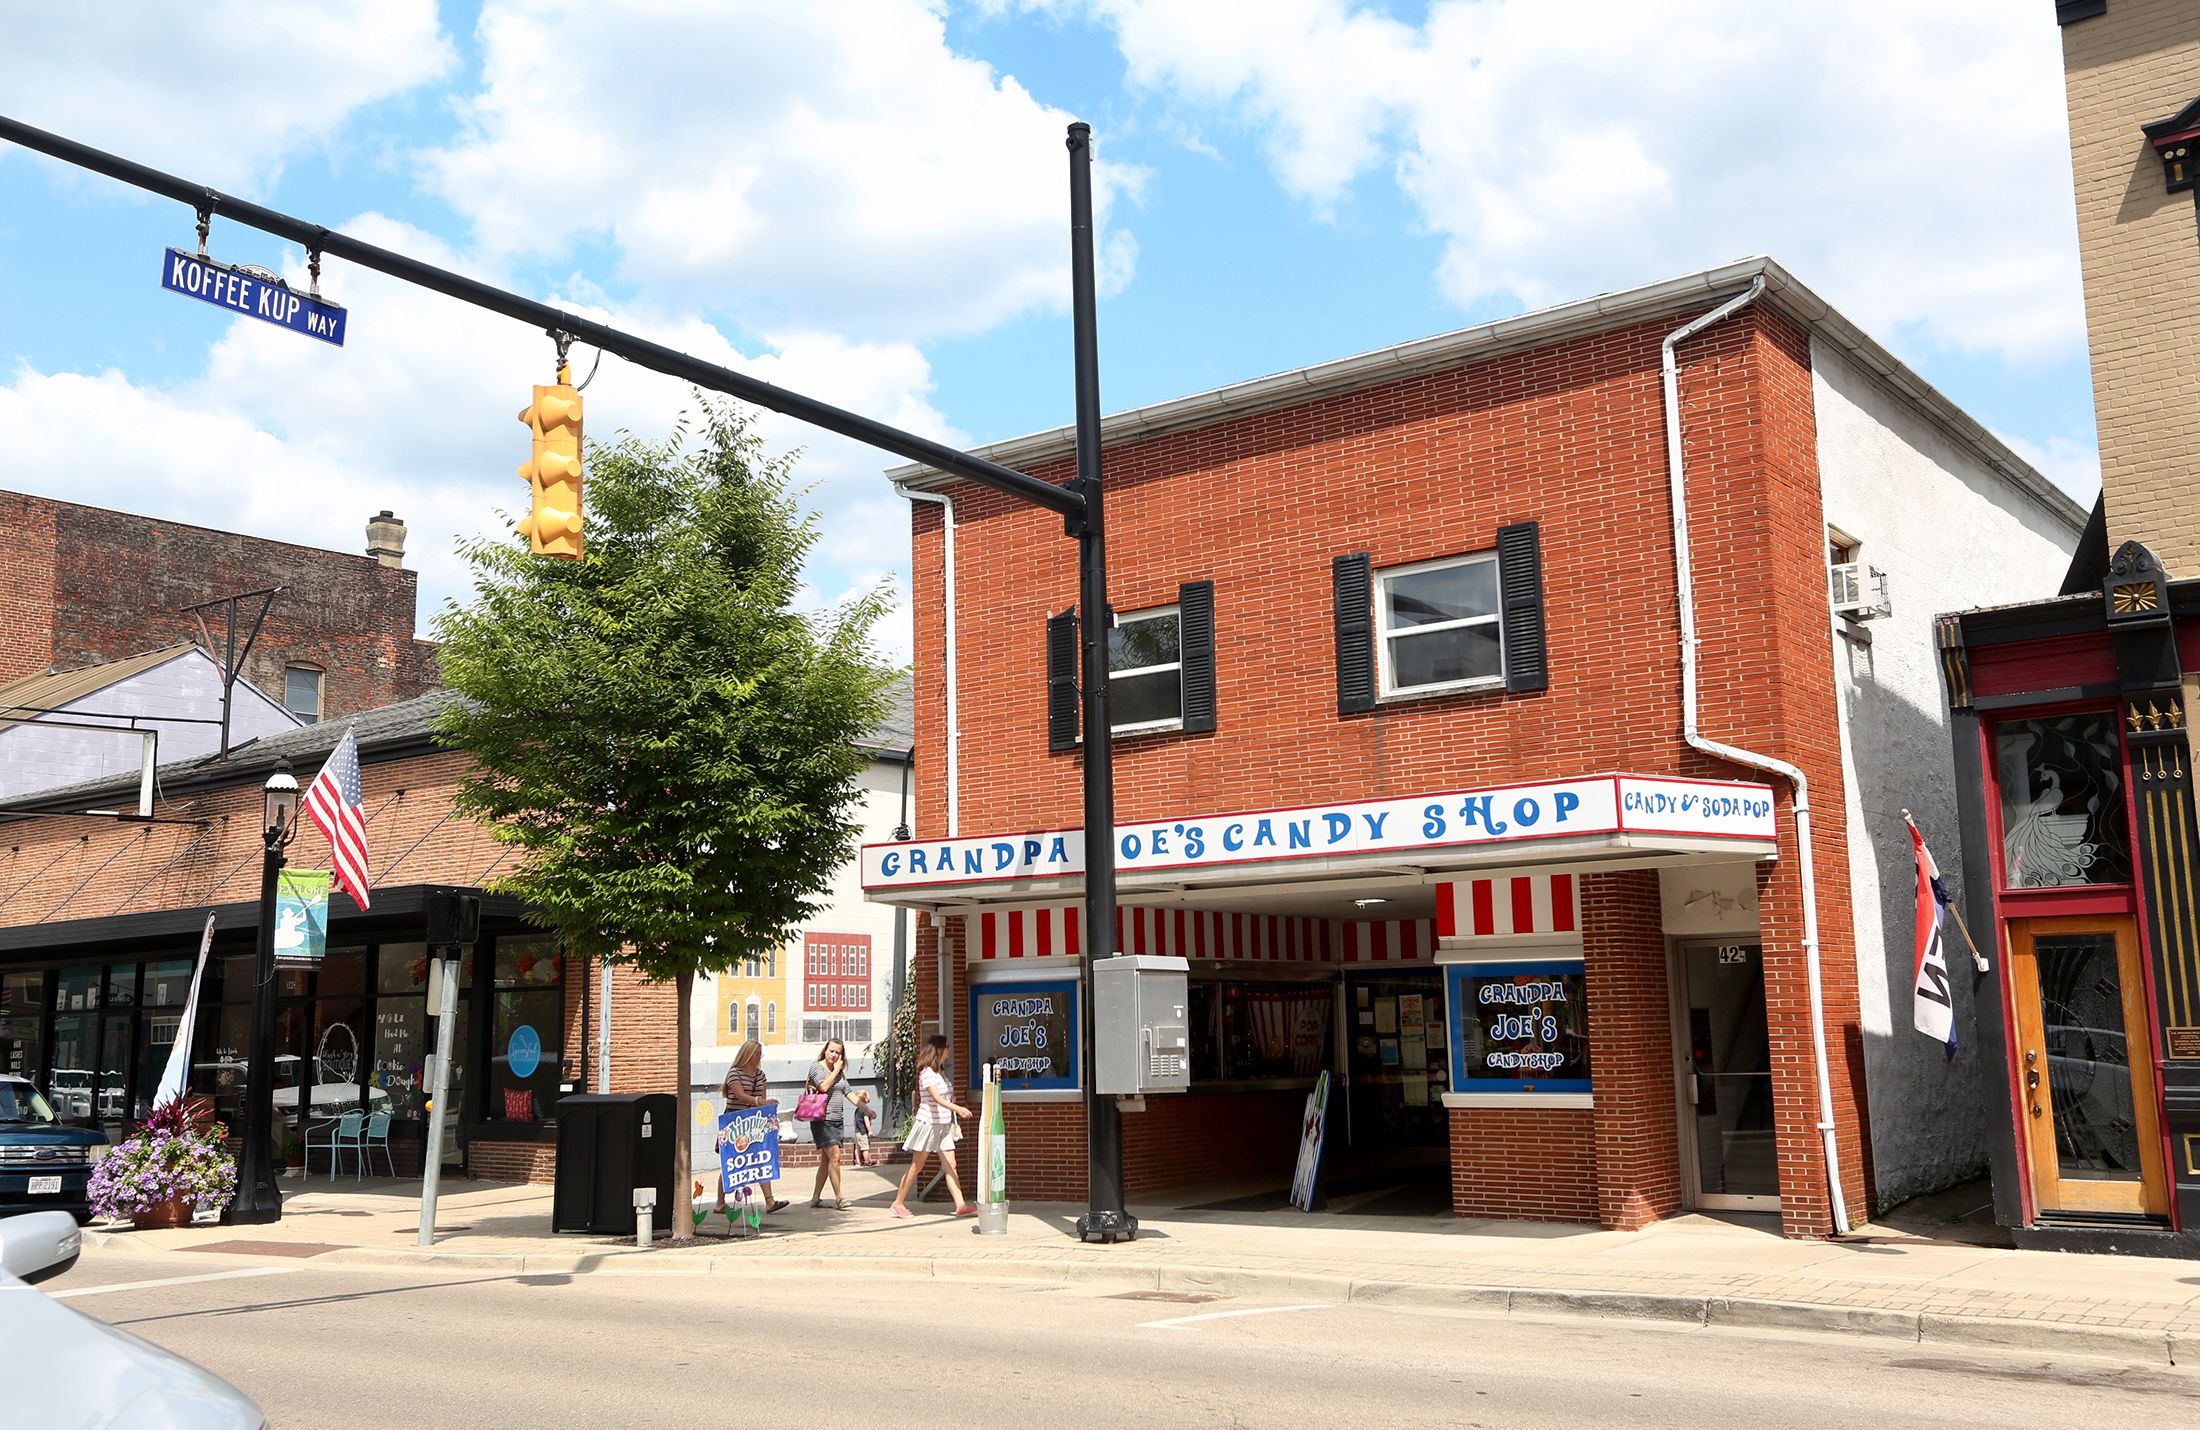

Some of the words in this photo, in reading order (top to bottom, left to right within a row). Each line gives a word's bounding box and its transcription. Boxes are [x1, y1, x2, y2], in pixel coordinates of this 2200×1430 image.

[171, 256, 253, 310] KOFFEE
[258, 286, 300, 324] KUP
[307, 310, 338, 338] WAY
[1624, 791, 1678, 814] CANDY
[1681, 794, 1699, 812] &
[1702, 797, 1741, 818] SODA
[1743, 799, 1770, 819] POP
[880, 836, 1070, 878] GRANDPA
[1120, 823, 1205, 860] OE'S
[1222, 811, 1390, 852] CANDY
[1423, 792, 1580, 840] SHOP
[279, 884, 327, 896] EXPLORE
[1479, 981, 1567, 1005] GRANDPA
[992, 997, 1054, 1018] GRANDPA
[384, 1028, 398, 1038] Had
[999, 1018, 1048, 1049] JOE'S
[1490, 1006, 1558, 1043] JOE'S
[376, 1059, 404, 1071] Cookie
[997, 1057, 1028, 1072] CANDY
[1026, 1057, 1052, 1073] SHOP
[1486, 1052, 1529, 1069] CANDY
[1529, 1052, 1565, 1071] SHOP
[386, 1073, 416, 1091] Dough
[726, 1150, 772, 1172] SOLD
[728, 1165, 774, 1188] HERE
